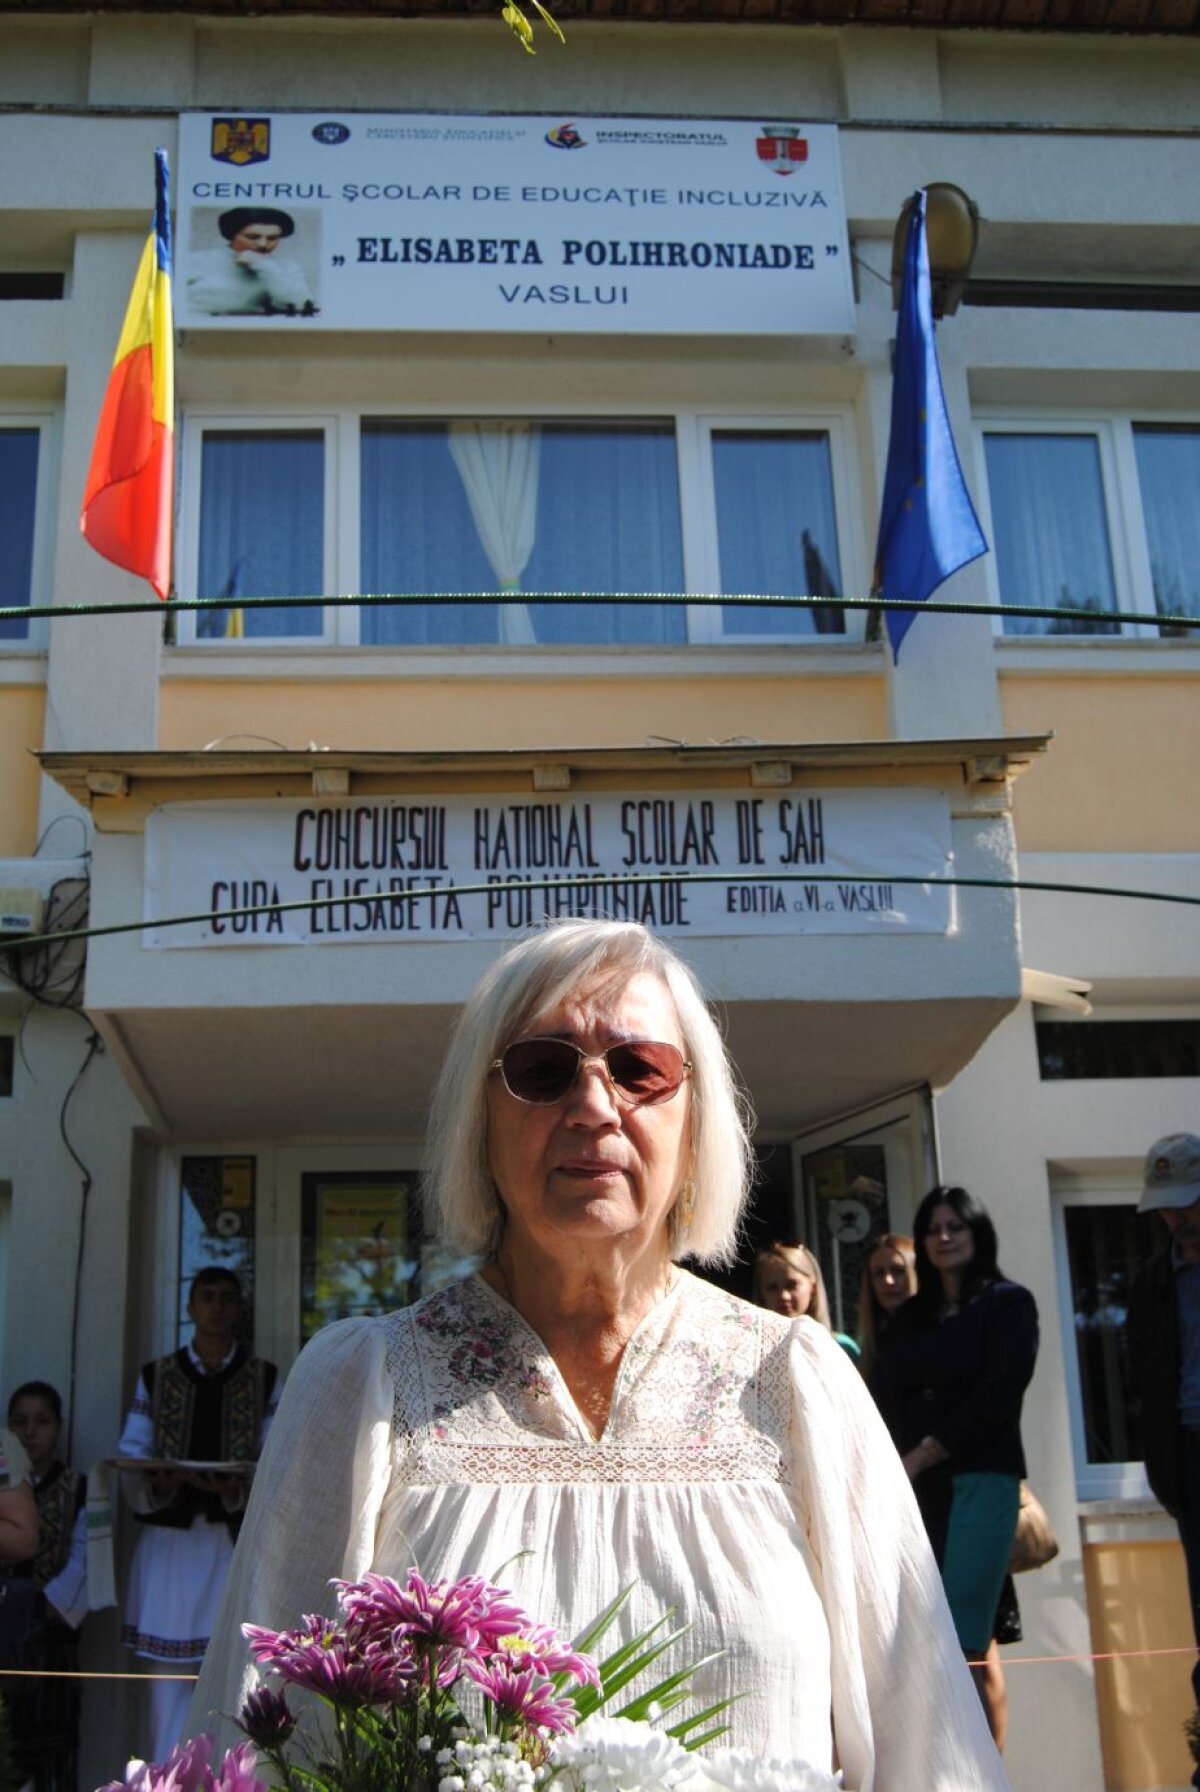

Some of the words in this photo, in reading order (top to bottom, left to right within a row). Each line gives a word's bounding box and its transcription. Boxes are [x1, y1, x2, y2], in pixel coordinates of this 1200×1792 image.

[596, 130, 726, 141] INSPECTORATUL
[192, 182, 331, 199] CENTRUL
[473, 186, 511, 201] DE
[679, 189, 828, 208] INCLUZIVĂ
[499, 284, 629, 305] VASLUI
[293, 806, 449, 872] CONCURSUL
[735, 799, 766, 865] DE
[211, 881, 284, 935] CUPA
[310, 875, 464, 934] ELISABETA
[838, 884, 894, 913] VASLUI
